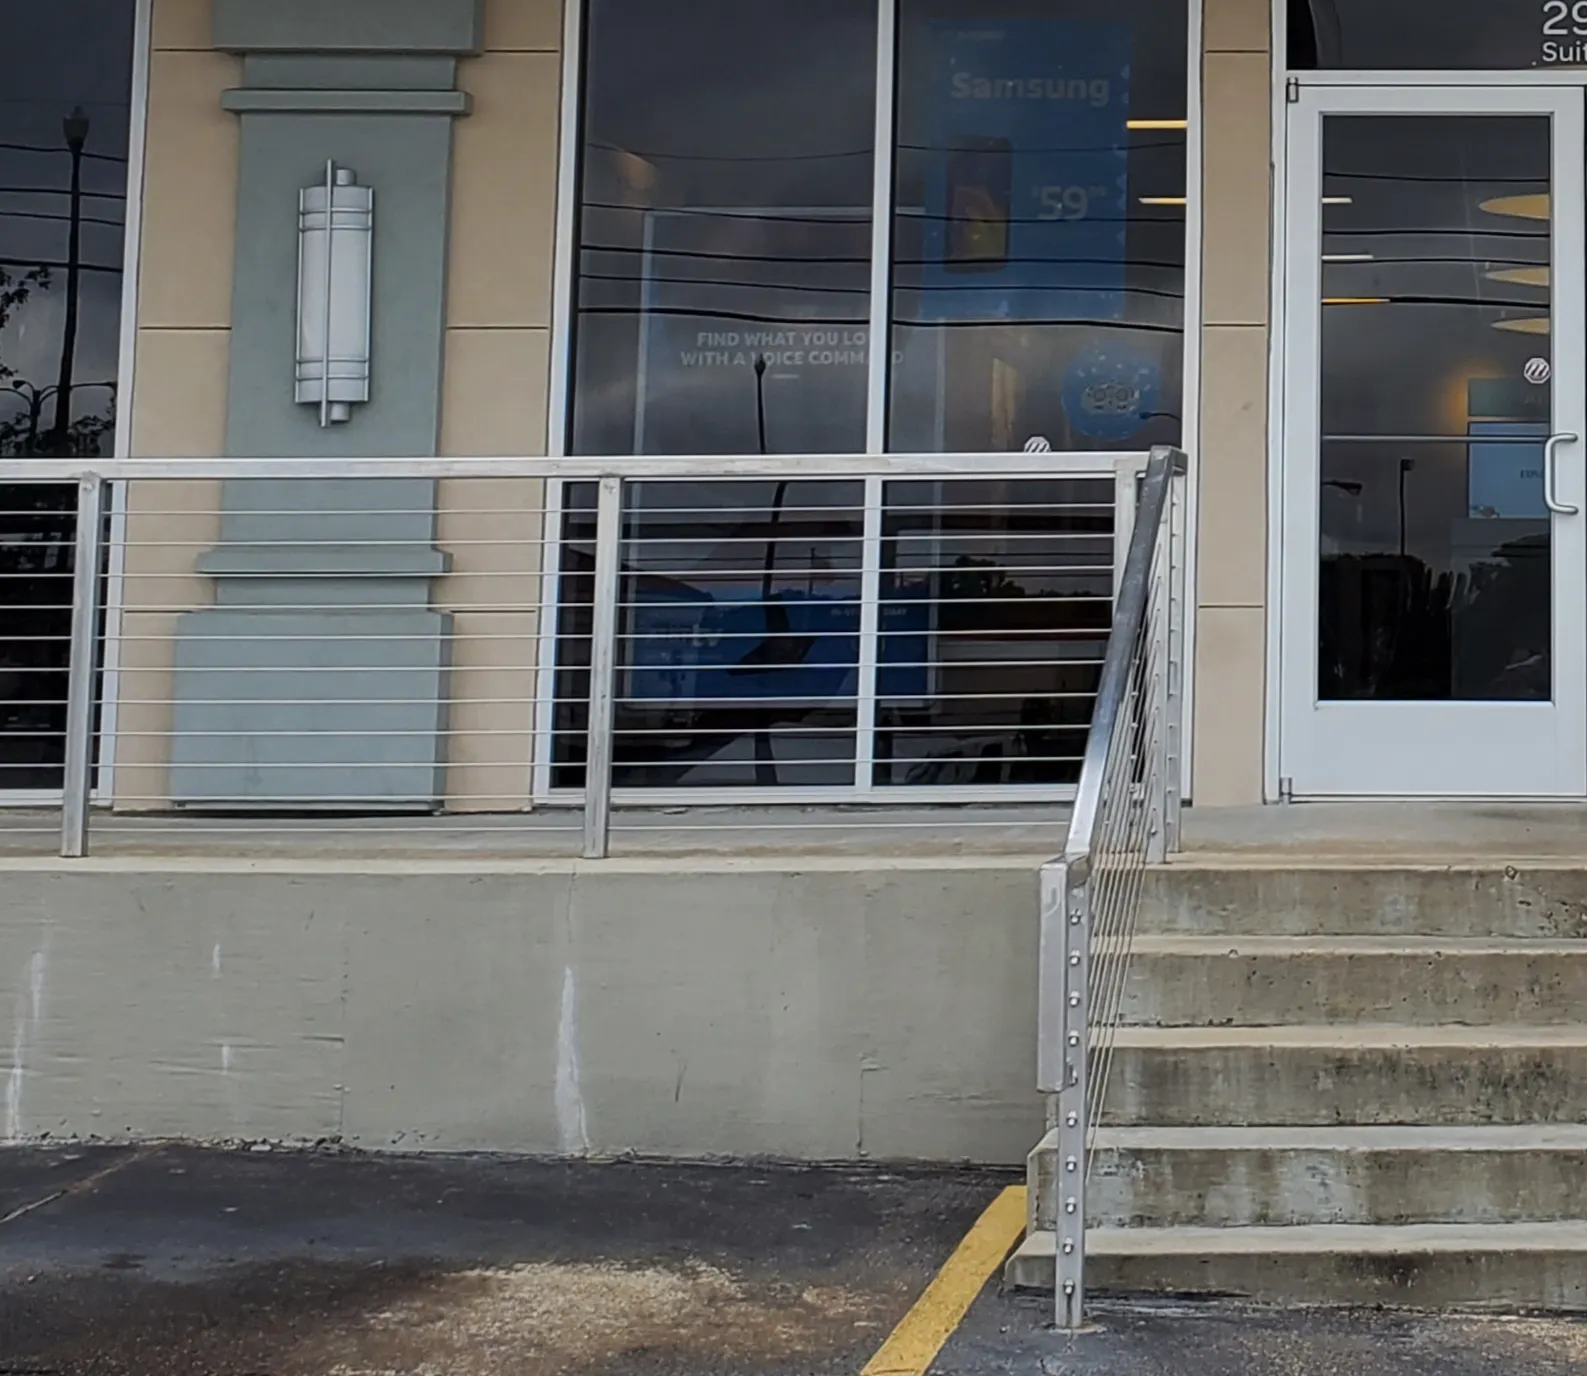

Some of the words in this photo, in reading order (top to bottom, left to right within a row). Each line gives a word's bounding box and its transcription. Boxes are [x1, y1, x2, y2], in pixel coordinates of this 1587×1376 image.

[951, 72, 1109, 107] Samsung
[697, 331, 740, 346] FIND
[745, 331, 797, 346] WHAT
[800, 331, 838, 346] YOU
[843, 331, 870, 346] LO
[681, 351, 729, 366] WITH
[733, 351, 746, 365] A
